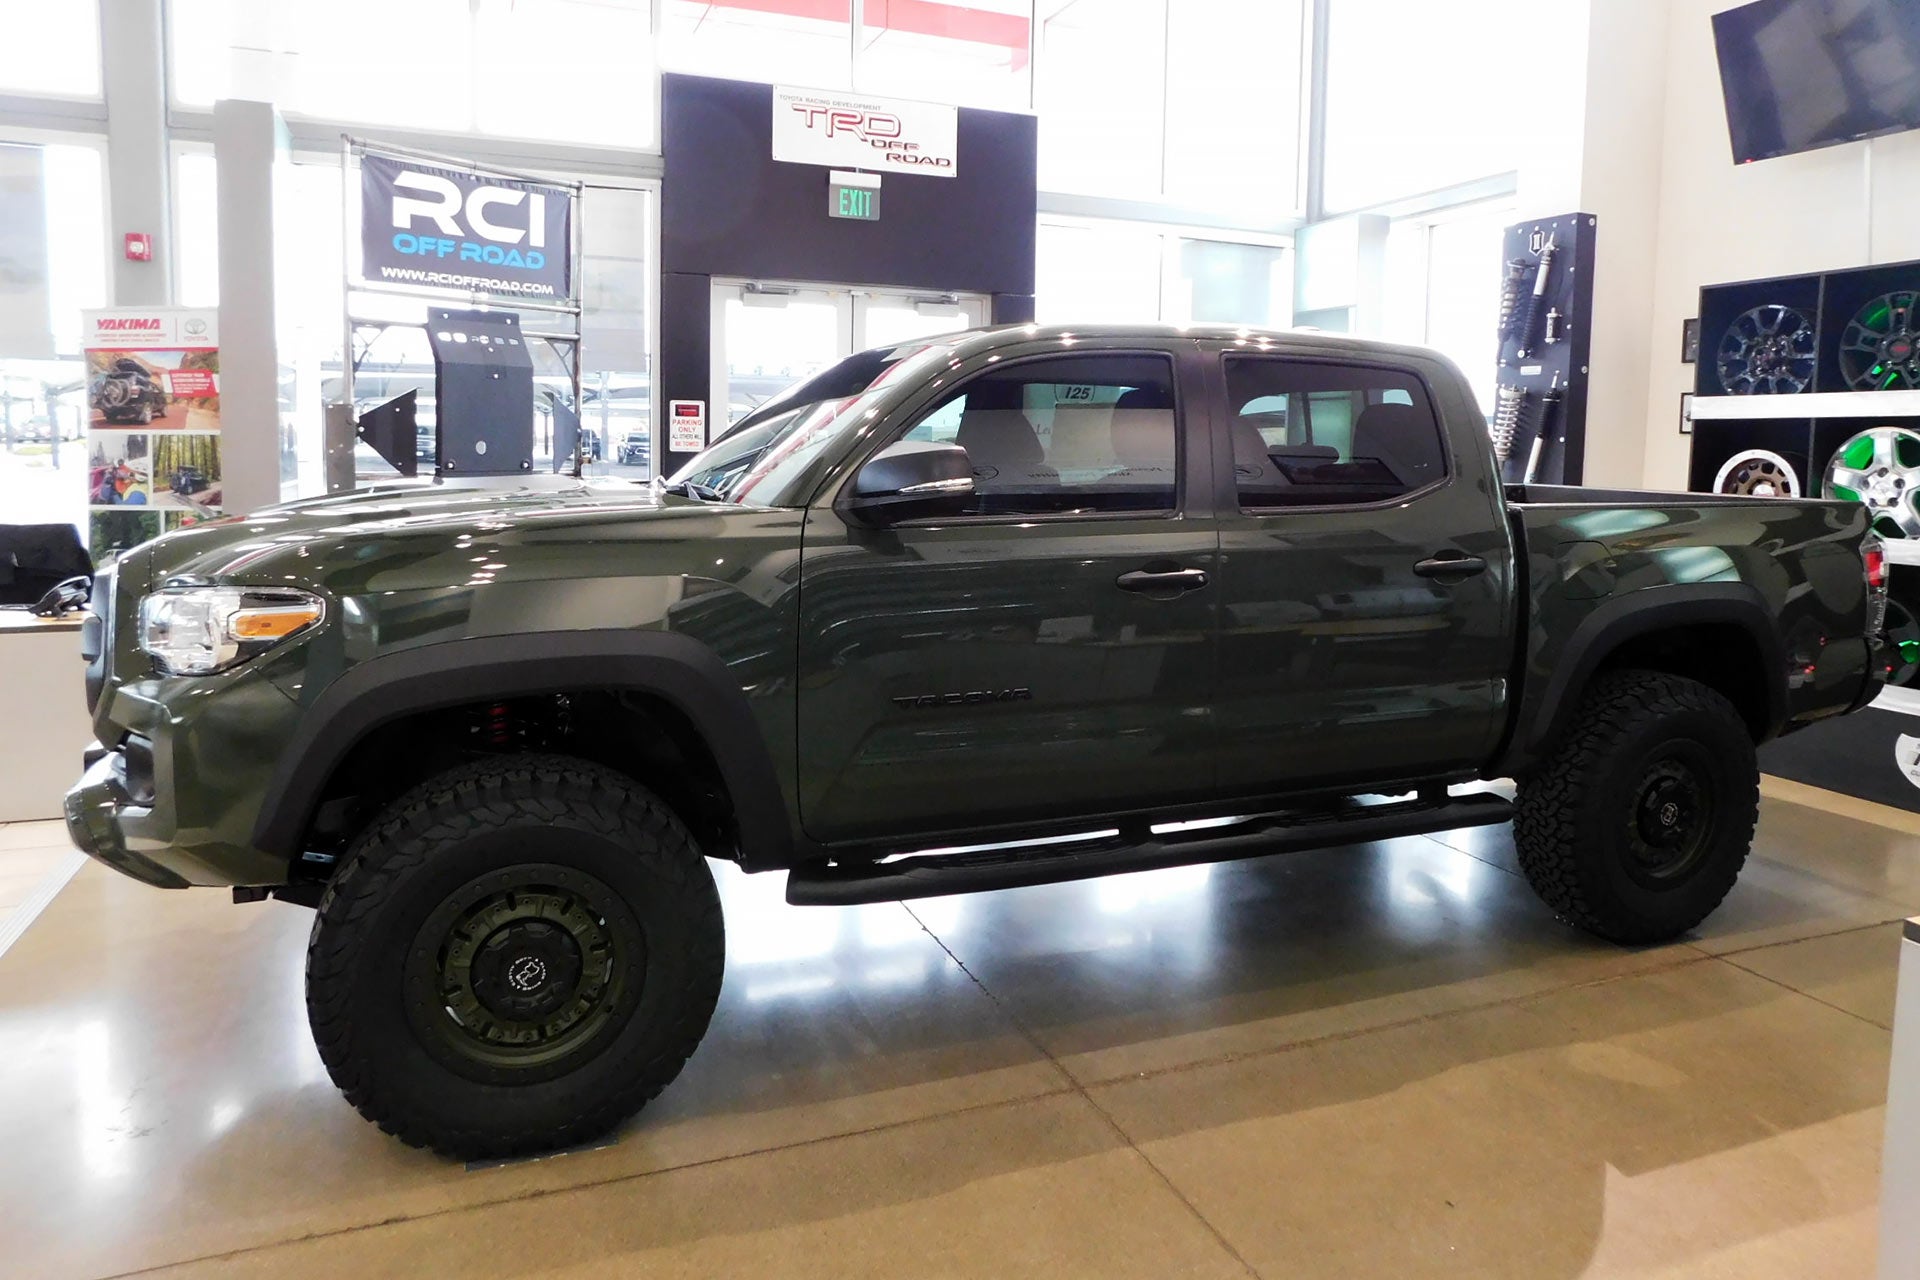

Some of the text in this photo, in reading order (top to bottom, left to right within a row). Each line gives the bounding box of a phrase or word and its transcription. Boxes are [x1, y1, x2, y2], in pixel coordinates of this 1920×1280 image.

[779, 94, 881, 111] TOYOTA RACING DEVELOPMENT
[792, 103, 901, 141] TRD
[871, 139, 920, 151] OFF
[886, 152, 952, 168] ROAD
[392, 170, 545, 248] RCI
[839, 188, 872, 217] EXIT
[392, 233, 546, 270] OFF ROAD
[381, 267, 554, 295] WWW.RCIOFFROAD.COM
[97, 319, 161, 330] YAKIMA
[1064, 387, 1090, 400] 125
